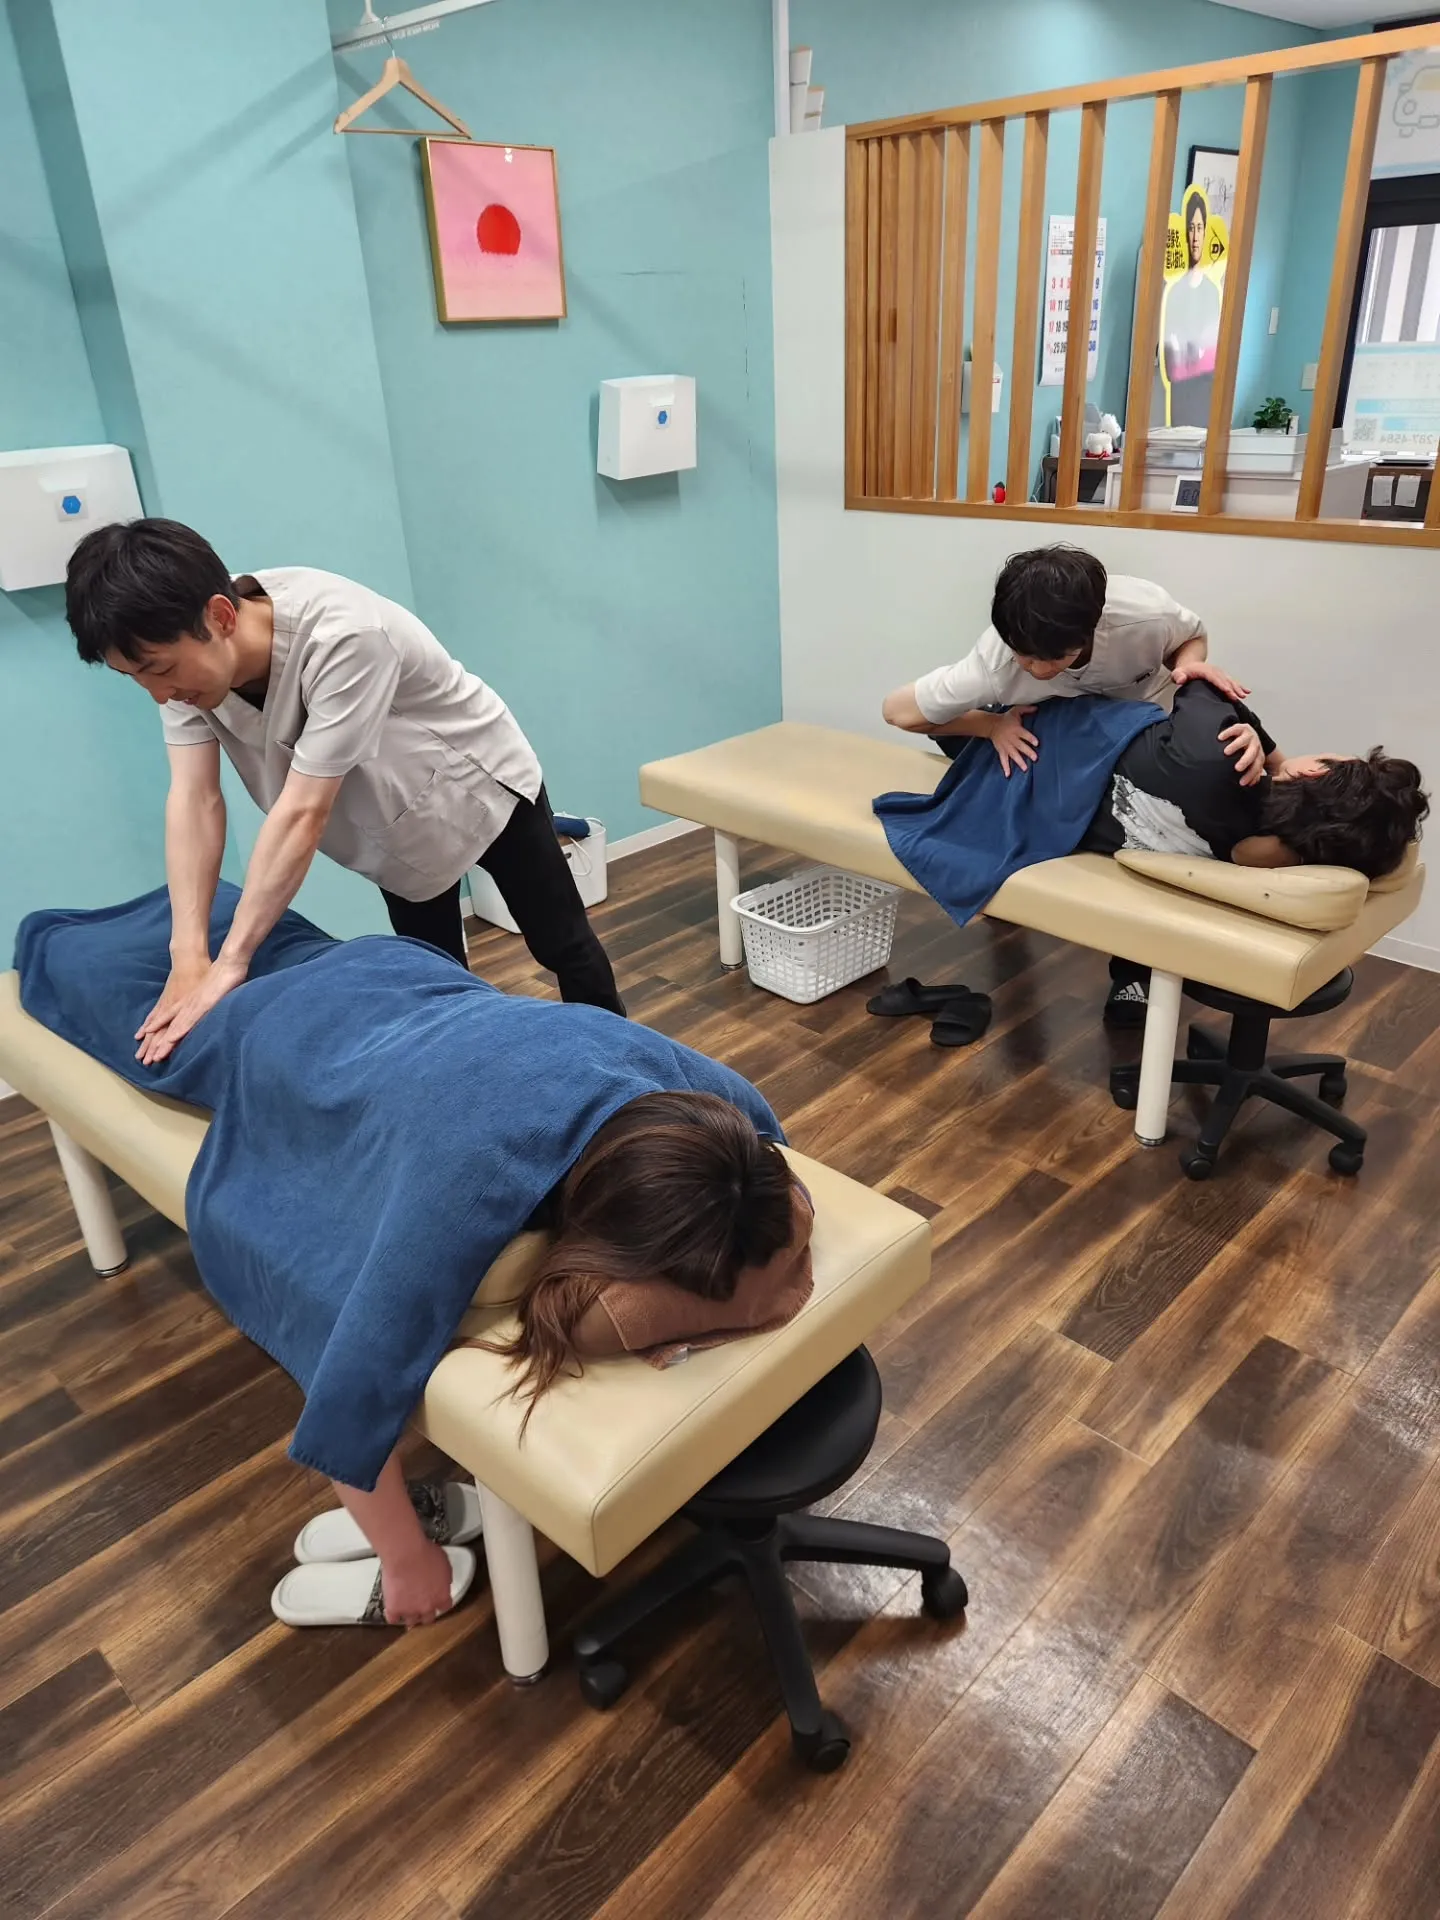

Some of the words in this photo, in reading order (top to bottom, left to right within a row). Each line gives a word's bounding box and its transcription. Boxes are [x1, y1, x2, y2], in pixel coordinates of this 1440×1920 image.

[1057, 300, 1063, 312] 11
[1049, 320, 1055, 333] 17
[1053, 342, 1060, 354] 25
